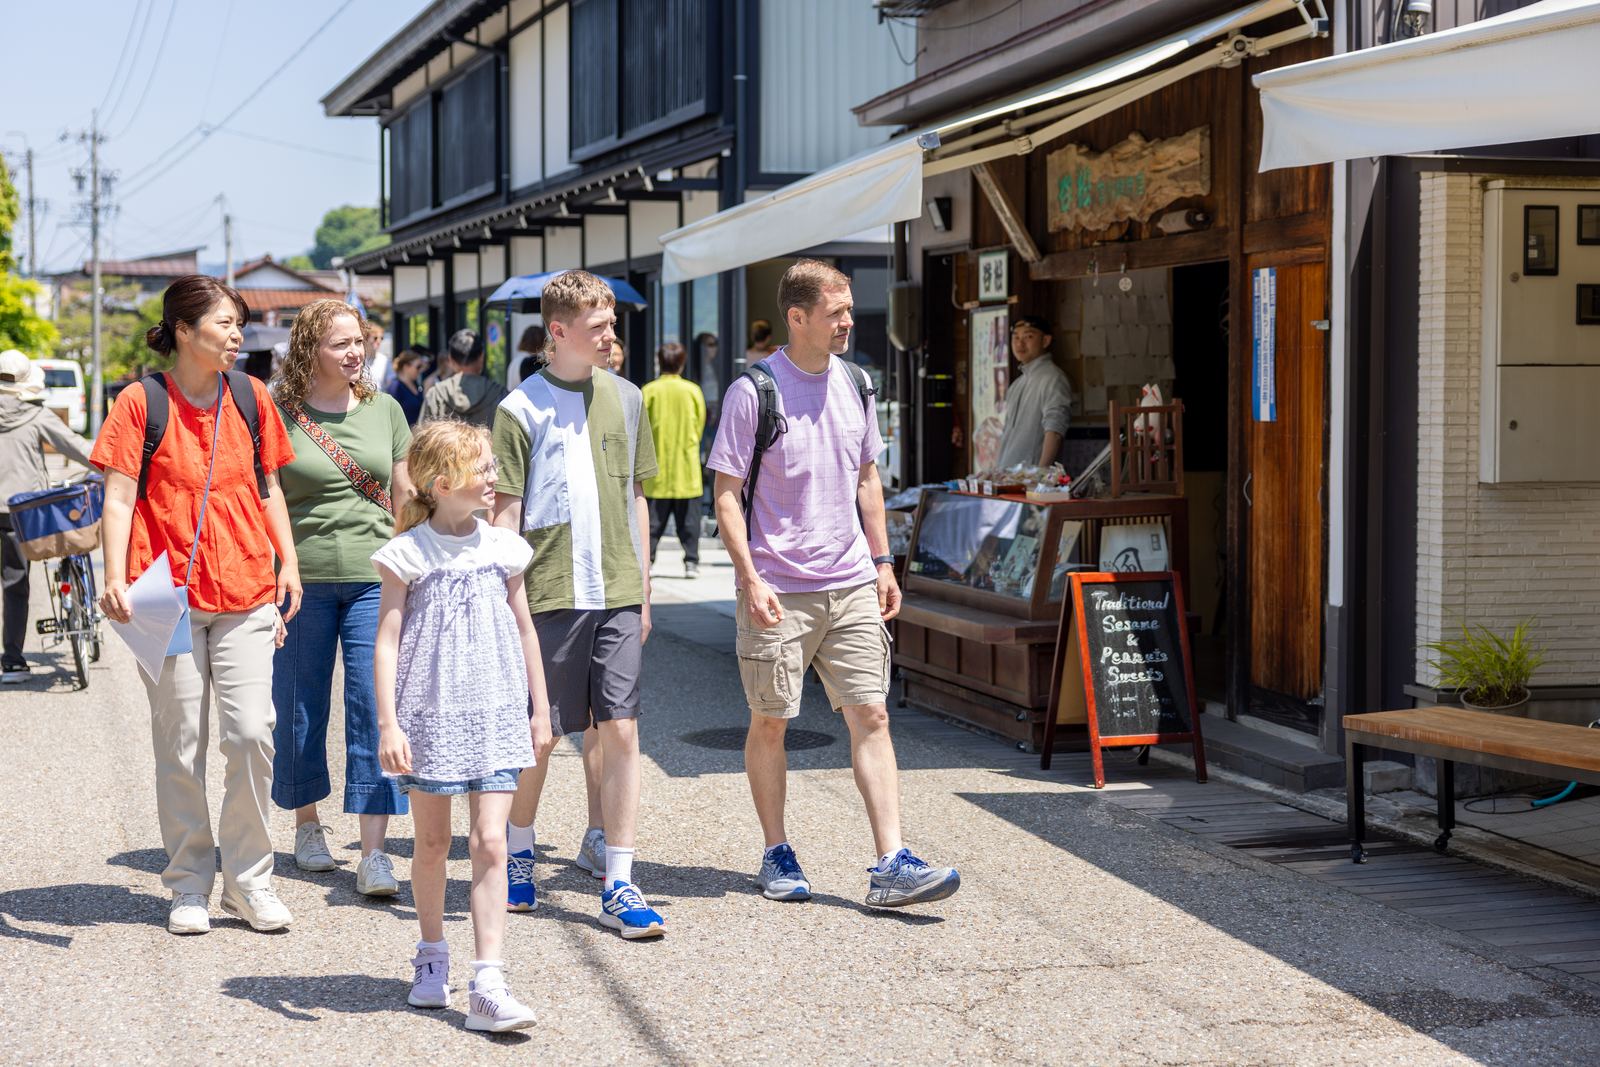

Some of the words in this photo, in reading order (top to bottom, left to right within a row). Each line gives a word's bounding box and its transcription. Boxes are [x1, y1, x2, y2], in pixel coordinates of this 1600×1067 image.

[1091, 590, 1169, 611] Traditional
[1102, 614, 1159, 633] Sesame
[1126, 633, 1139, 646] &
[1100, 646, 1168, 664] Peanuts
[1107, 666, 1163, 685] Sweets
